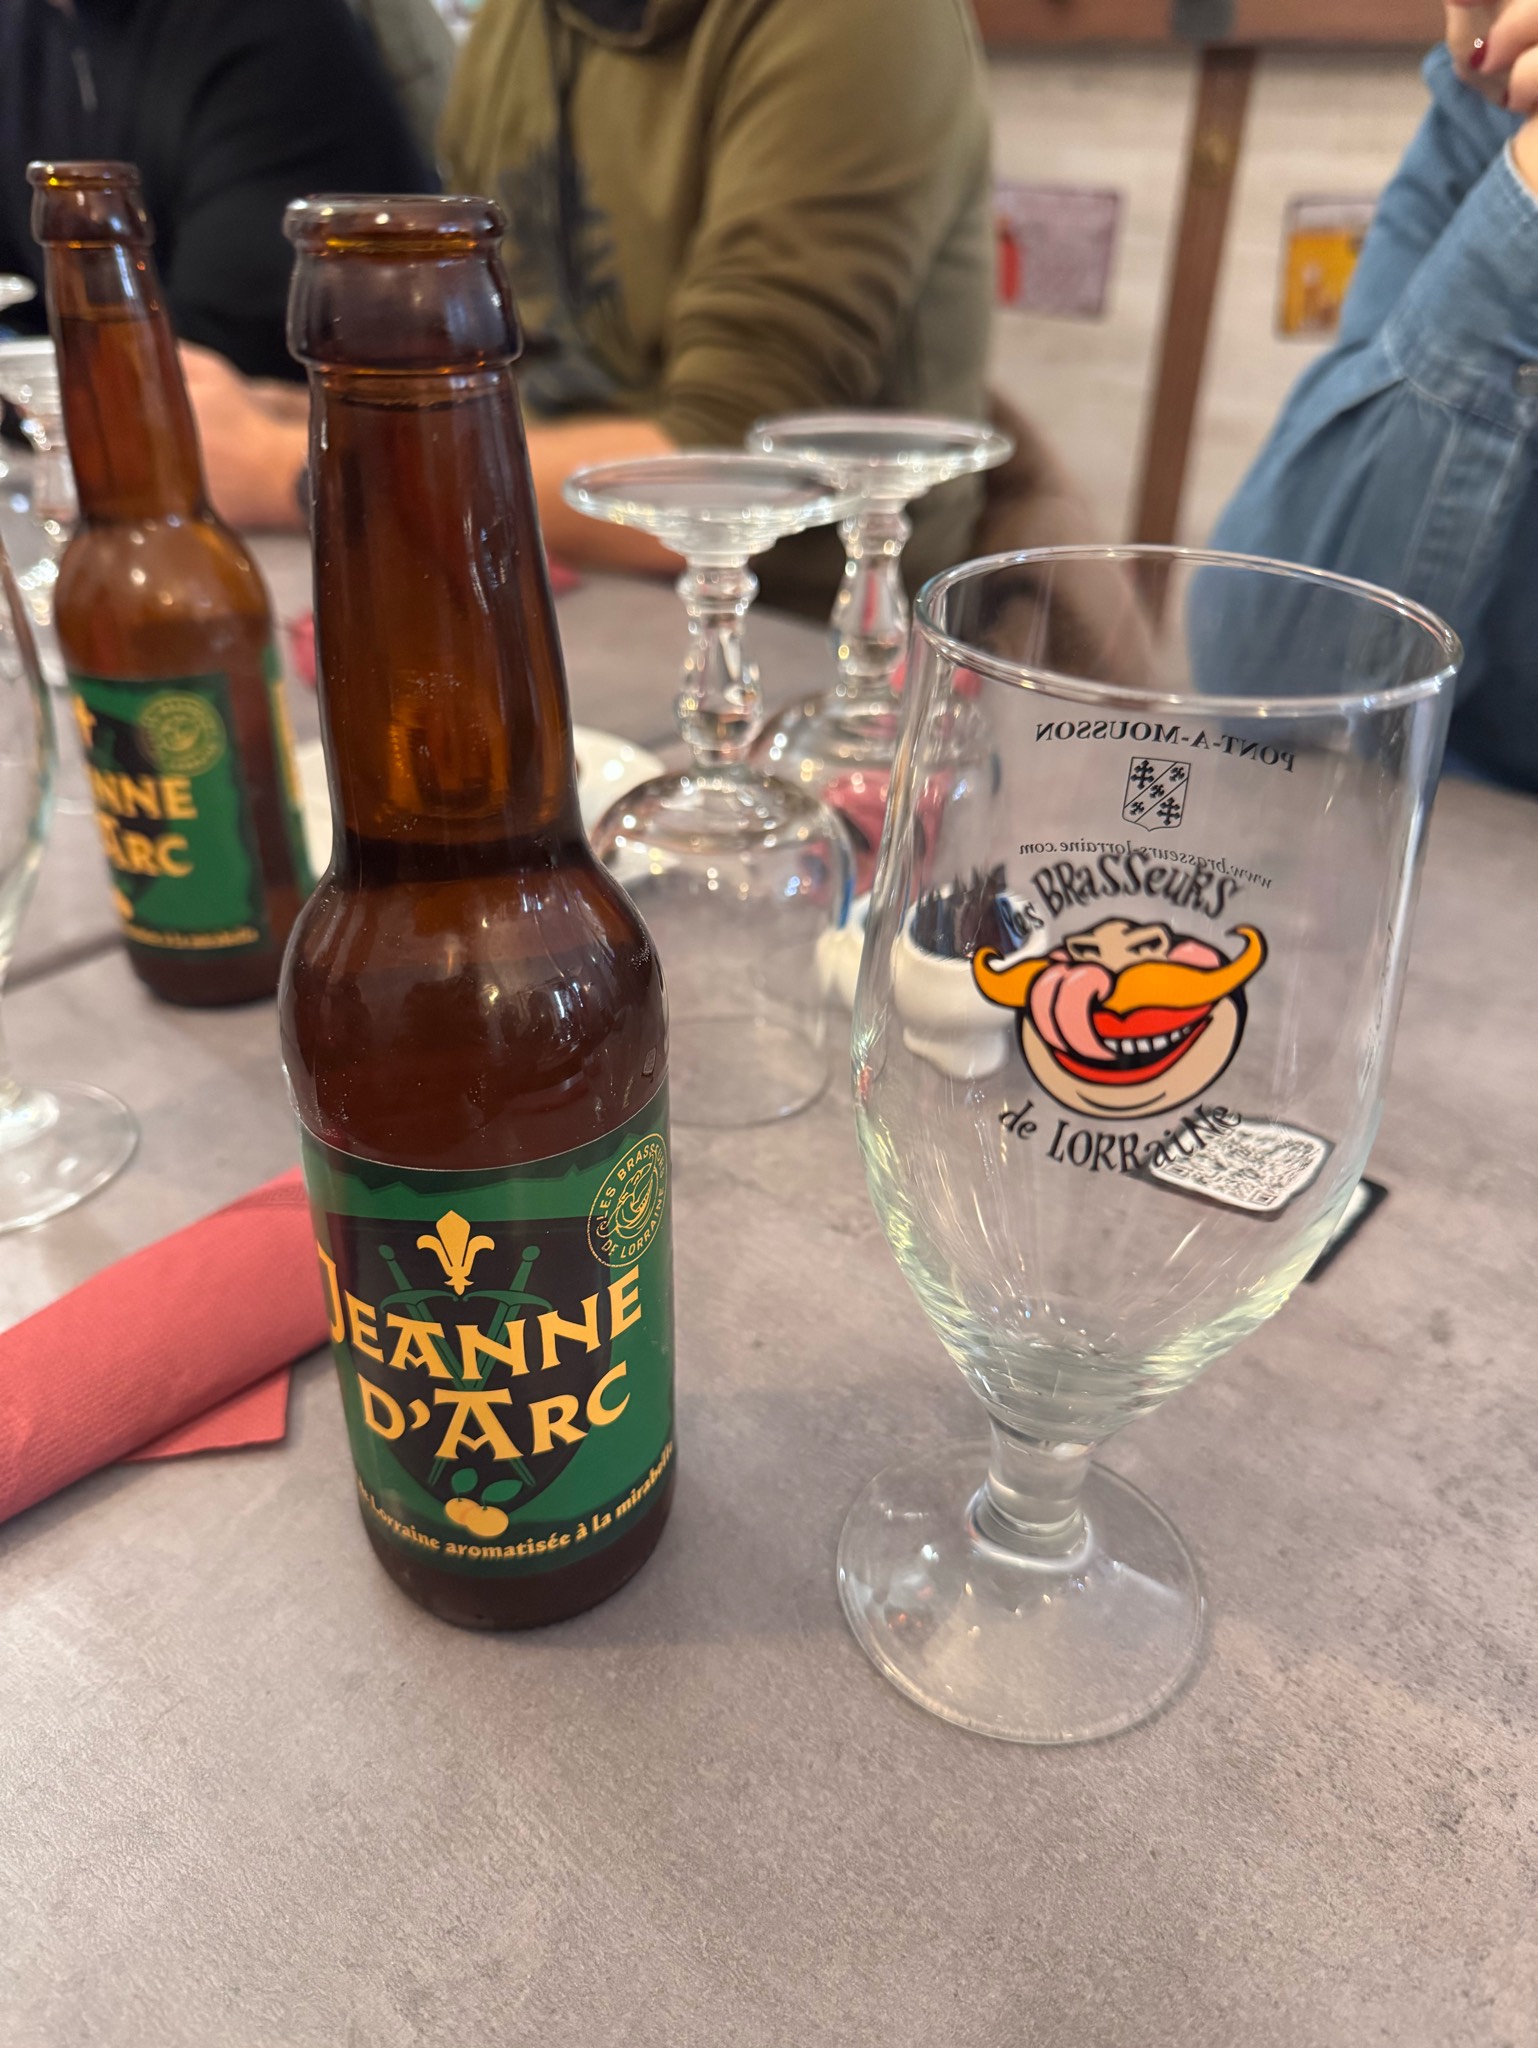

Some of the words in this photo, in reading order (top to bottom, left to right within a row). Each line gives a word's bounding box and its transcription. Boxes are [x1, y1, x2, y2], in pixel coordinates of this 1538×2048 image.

[998, 1100, 1037, 1140] de
[596, 1186, 616, 1221] LES
[601, 1239, 620, 1256] DE
[620, 1188, 664, 1259] LORRAINE
[316, 1240, 643, 1382] JEANNE
[445, 1532, 572, 1559] aromatisée
[575, 1522, 589, 1542] à
[591, 1514, 613, 1535] la
